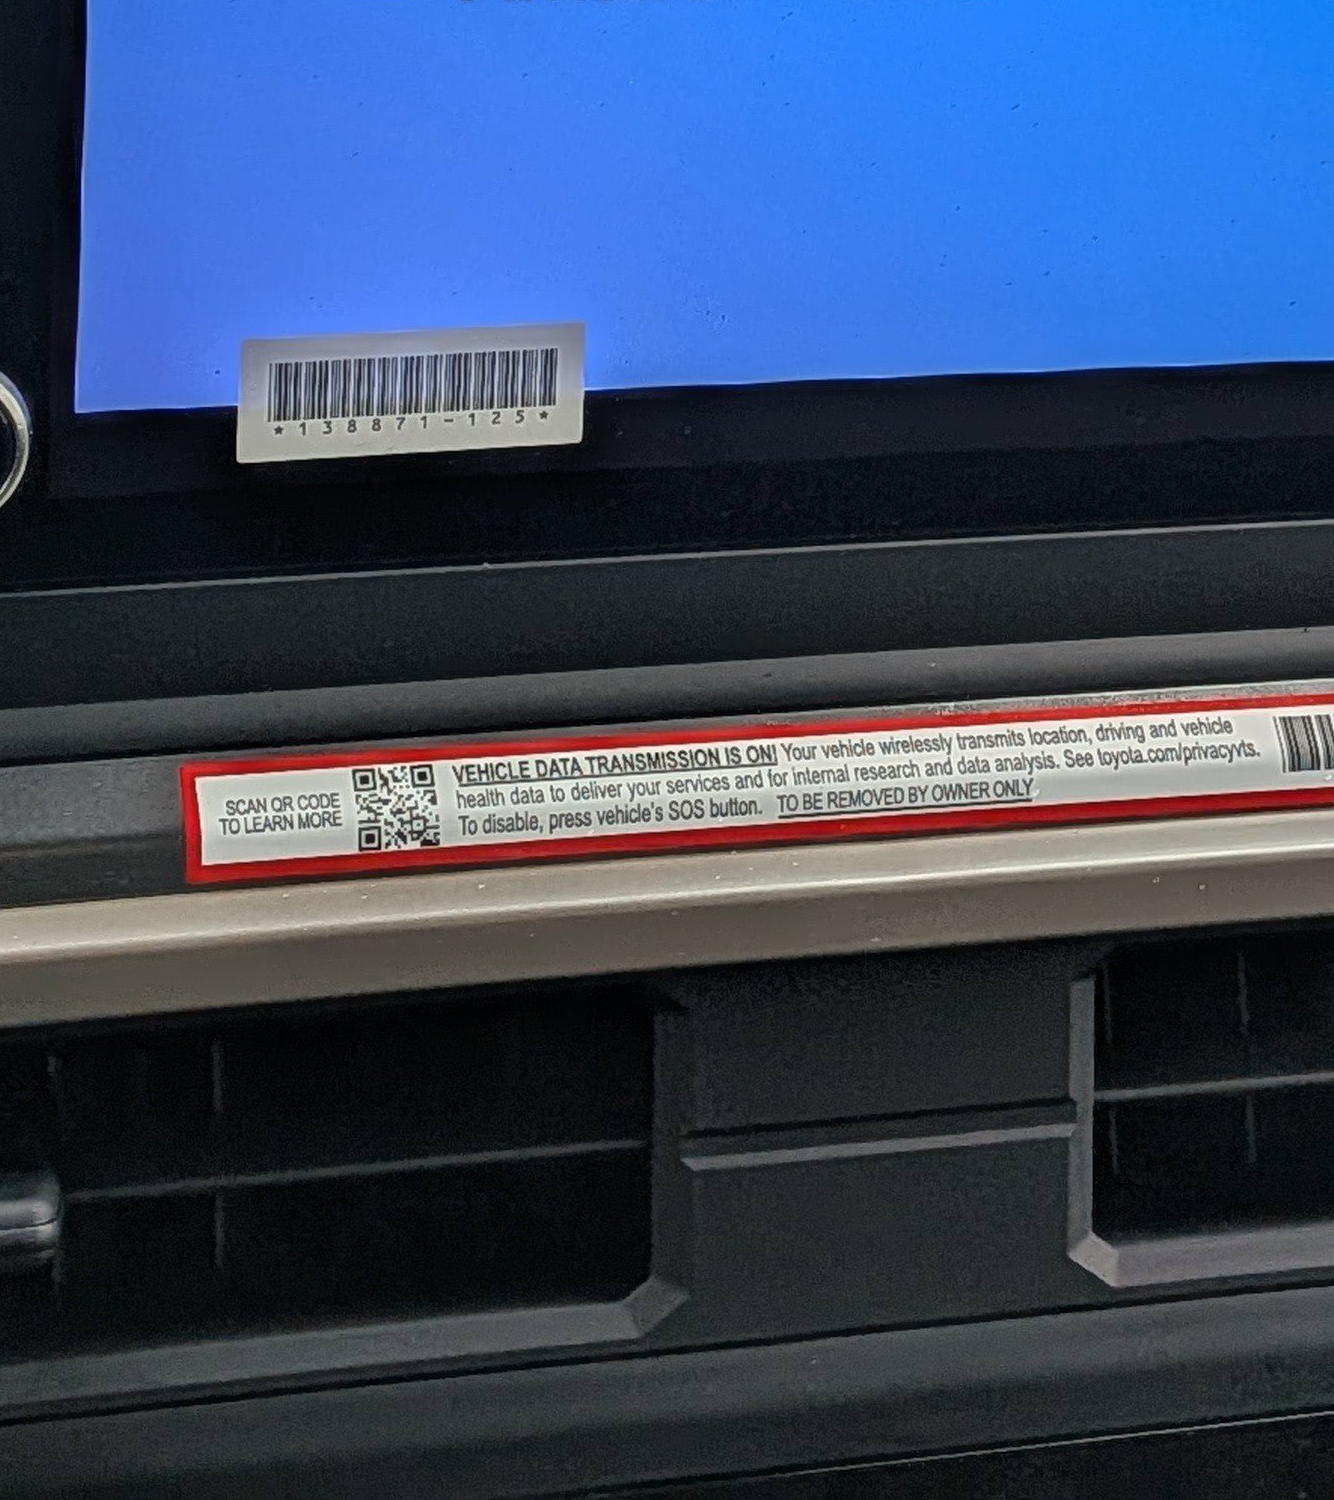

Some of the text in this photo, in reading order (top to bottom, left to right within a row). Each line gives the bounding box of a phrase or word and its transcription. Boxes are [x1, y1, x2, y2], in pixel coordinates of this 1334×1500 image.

[452, 760, 531, 784] VEHICLE
[535, 756, 583, 778] DATA
[584, 748, 719, 775] TRANSMISSION
[725, 746, 742, 766] IS
[780, 742, 818, 763] Your
[823, 736, 875, 760] vehicle
[878, 733, 953, 756] wirelessly
[956, 729, 1025, 752] transmits
[1028, 724, 1094, 747] location,
[1095, 721, 1145, 744] driving
[1149, 719, 1176, 739] and
[1181, 716, 1234, 736] vehicle
[225, 799, 268, 816] SCAN
[297, 792, 341, 811] CODE
[455, 790, 506, 810] health
[510, 787, 545, 807] data
[550, 785, 566, 804] to
[571, 780, 623, 803] deliver
[627, 780, 662, 802] your
[666, 774, 730, 794] services
[735, 770, 764, 790] and
[767, 768, 788, 788] for
[792, 764, 850, 786] internal
[854, 760, 918, 782] research
[922, 757, 953, 778] and
[957, 755, 991, 776] data
[995, 749, 1060, 776] analysis.
[1064, 749, 1094, 769] See
[458, 778, 1035, 836] To disable, press vehicle's SOS button. TO BE REMOVED BY OWNER ONLY
[219, 810, 343, 835] TO LEARN MORE
